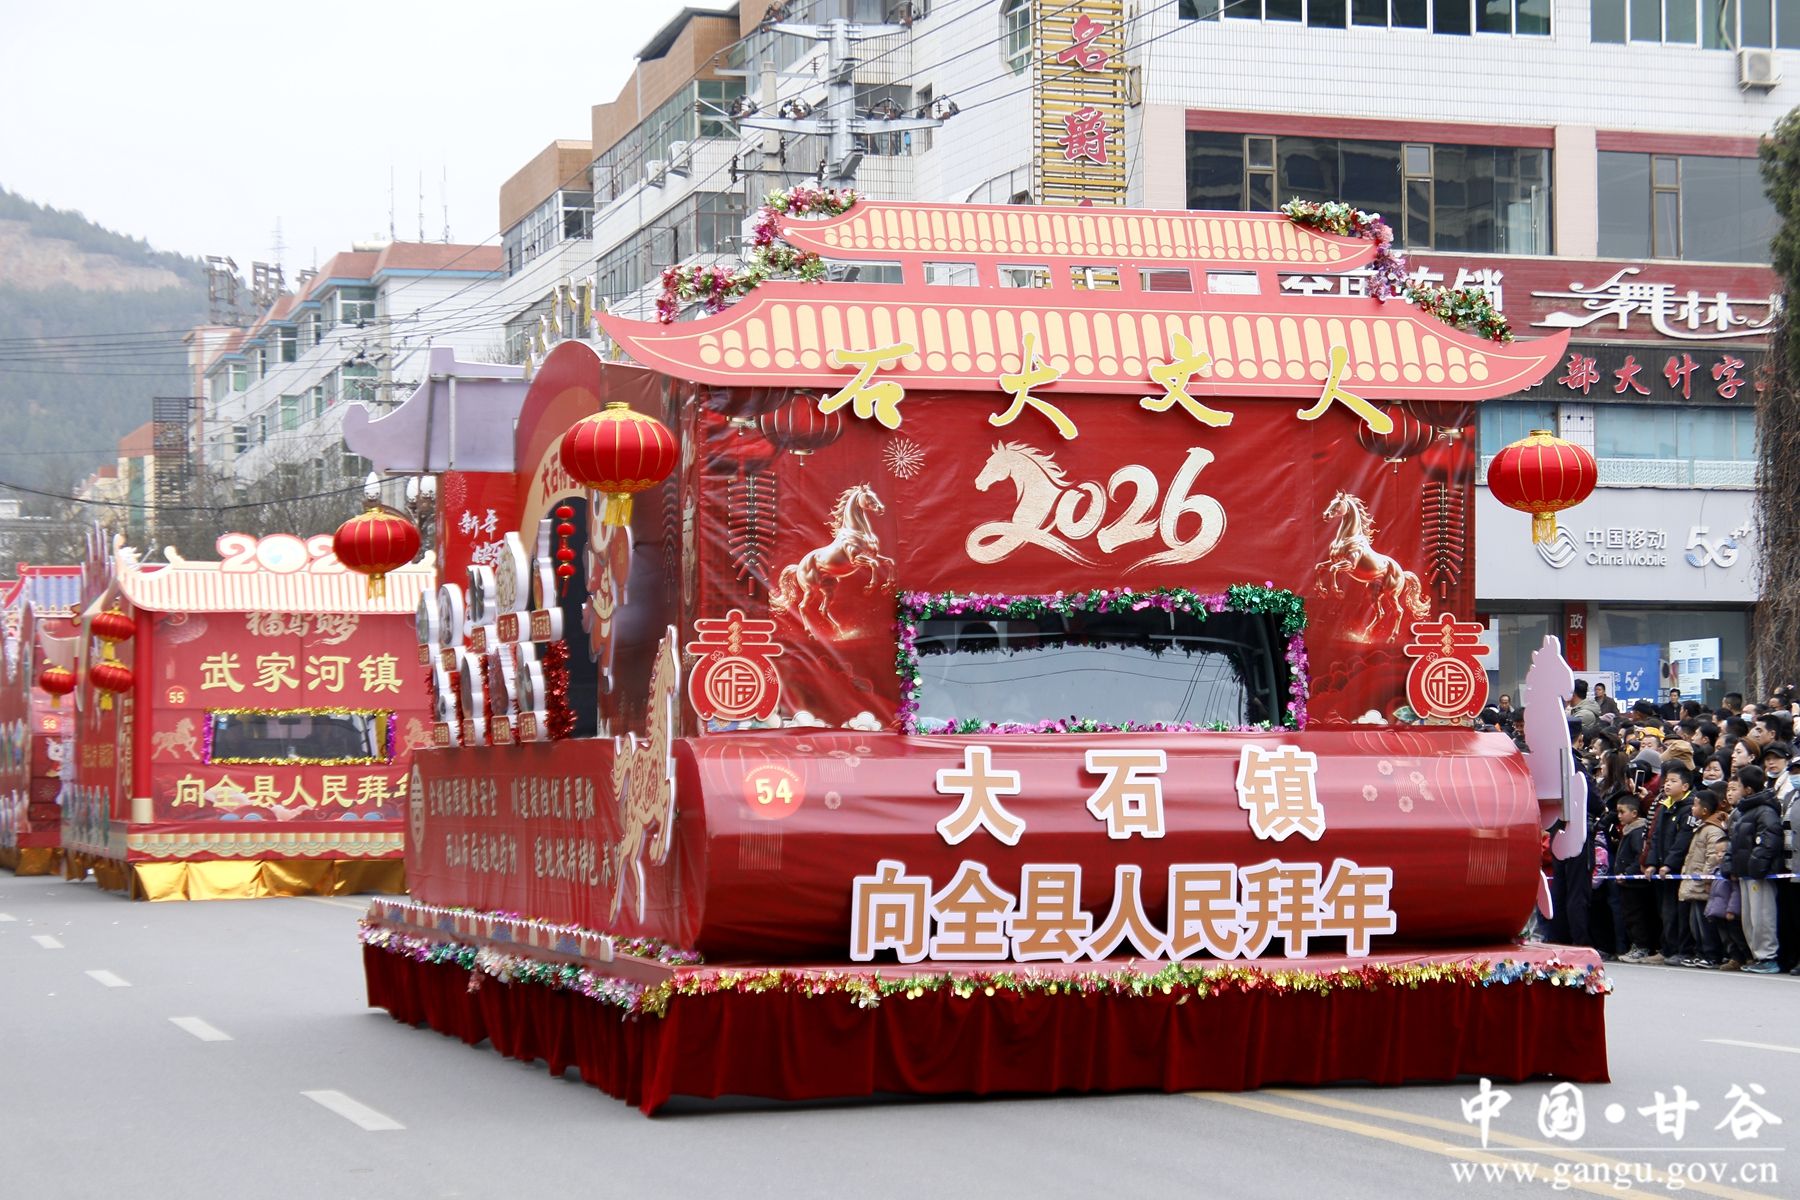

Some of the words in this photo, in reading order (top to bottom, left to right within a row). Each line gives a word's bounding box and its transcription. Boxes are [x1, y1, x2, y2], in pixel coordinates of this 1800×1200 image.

[1057, 14, 1112, 206] 名爵
[964, 438, 1228, 574] 2026
[1585, 527, 1668, 550] 中国移动
[1586, 552, 1624, 567] China
[1626, 551, 1668, 567] Mobile
[200, 651, 404, 694] 武家河镇
[168, 691, 185, 704] 55
[755, 778, 793, 805] 54
[936, 745, 1326, 847] 大石镇
[850, 860, 1396, 963] 向全县人民拜年
